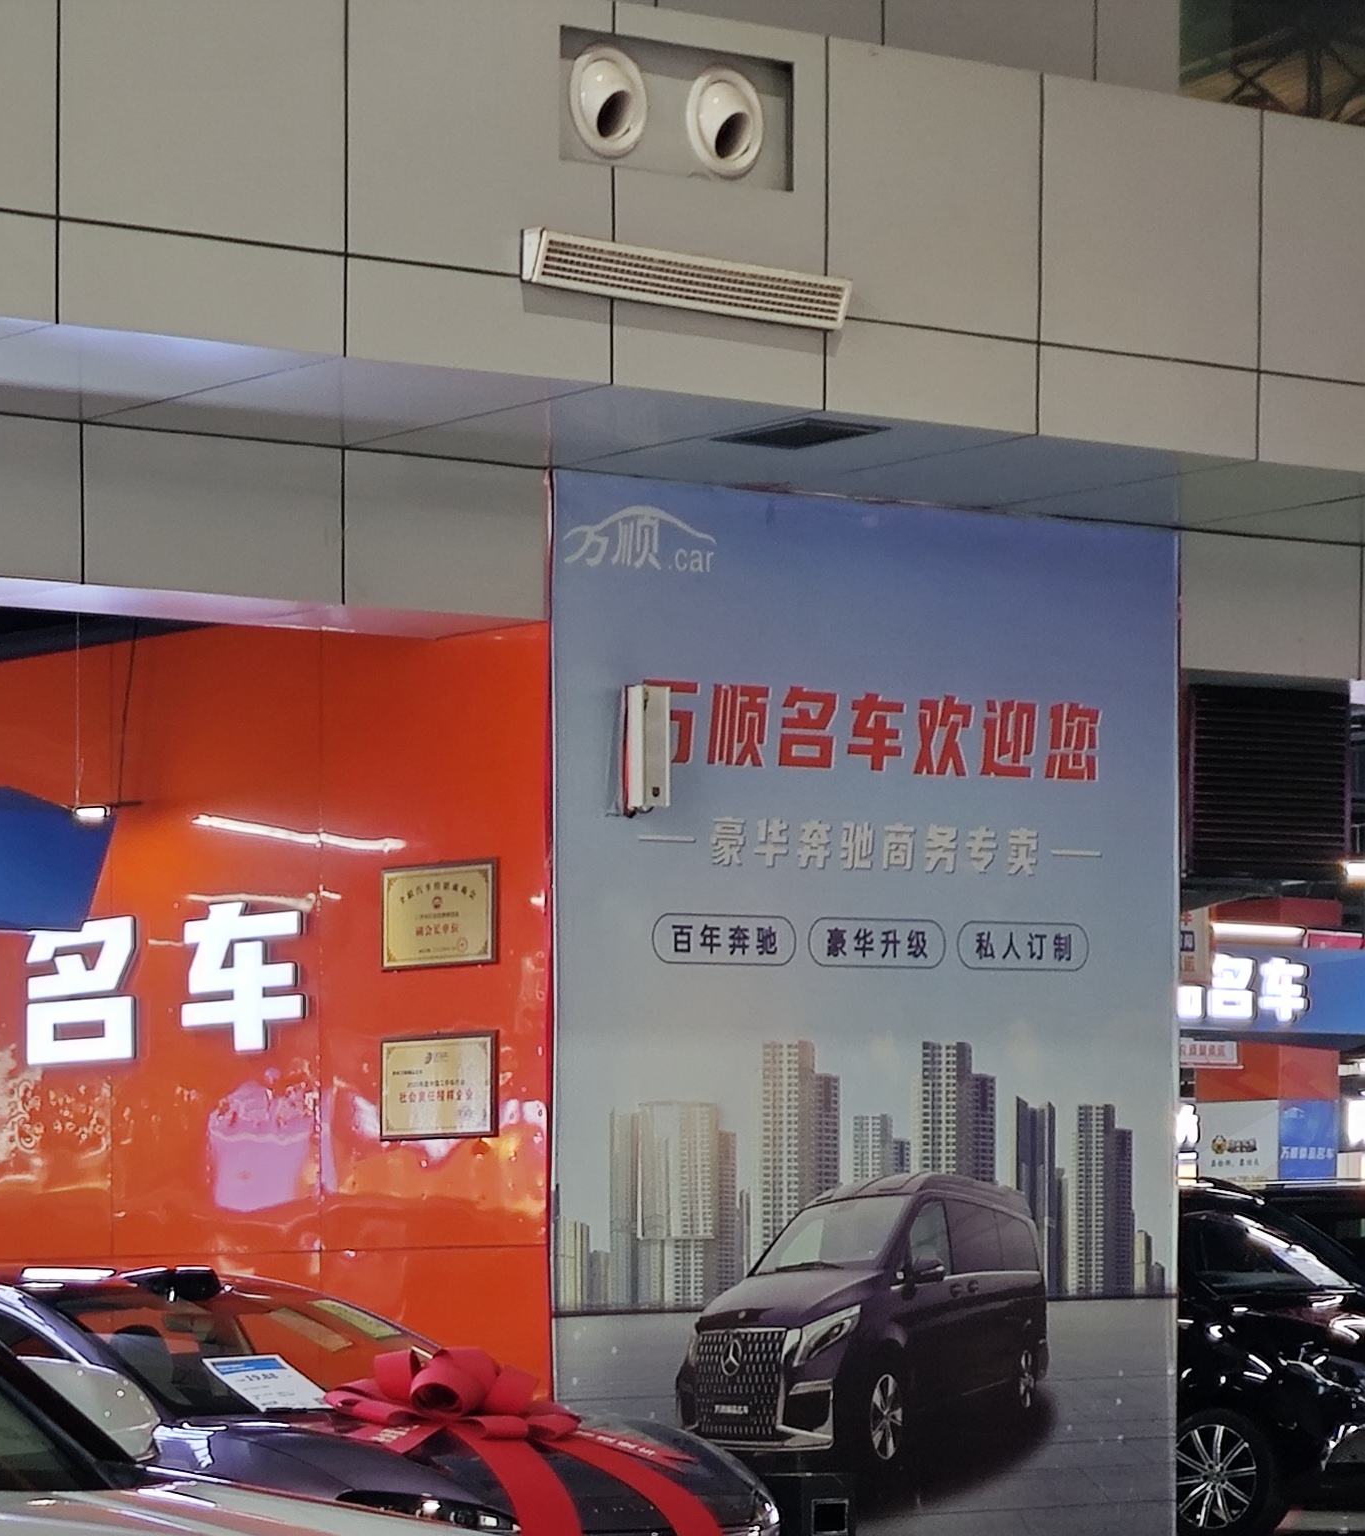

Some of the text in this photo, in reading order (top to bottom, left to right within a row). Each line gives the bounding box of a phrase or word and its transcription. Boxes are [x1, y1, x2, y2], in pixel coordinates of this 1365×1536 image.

[709, 817, 1040, 876] 豪华奔驰商务专卖
[672, 925, 778, 957] 百年奔驰
[827, 929, 929, 959] 豪华升级
[976, 932, 1072, 962] 私人订制
[1177, 953, 1310, 1021] 名车
